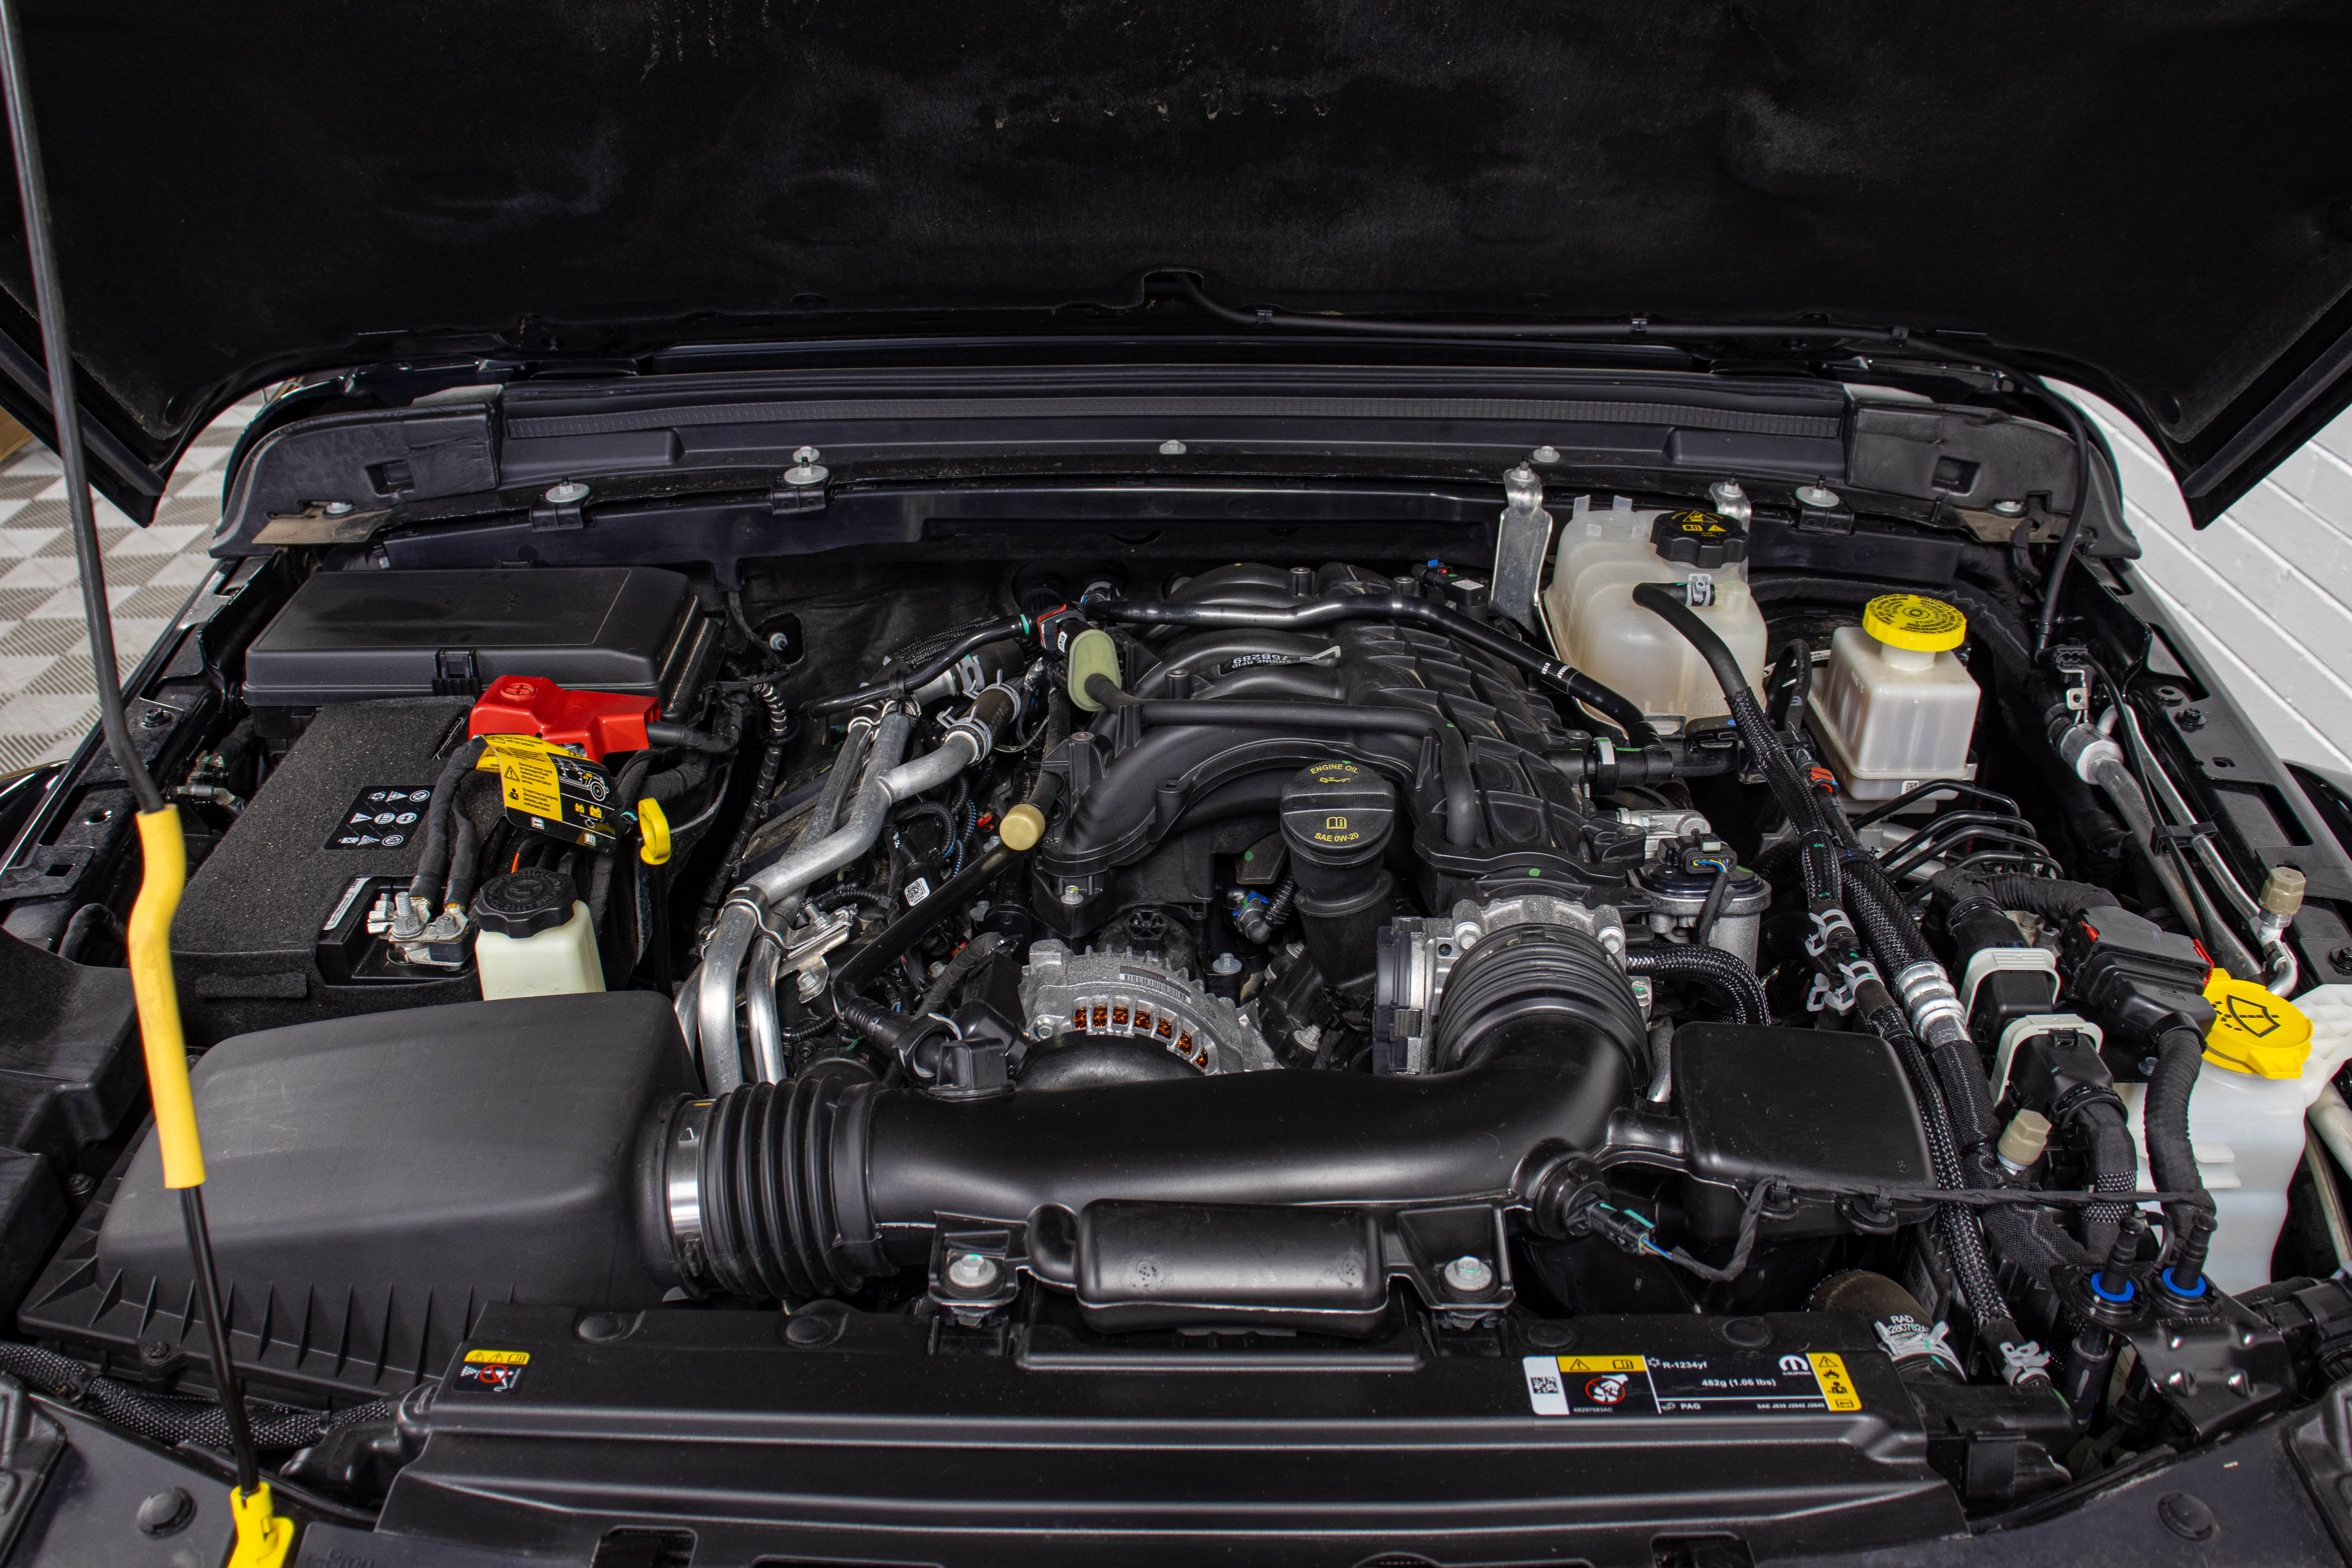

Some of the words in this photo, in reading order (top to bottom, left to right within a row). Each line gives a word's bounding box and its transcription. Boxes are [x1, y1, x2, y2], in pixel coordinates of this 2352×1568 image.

[1233, 654, 1288, 664] 75B289
[1310, 764, 1343, 775] ENGINE
[1344, 765, 1359, 774] OIL
[1314, 833, 1332, 842] SAE
[1334, 832, 1360, 842] 0W-20
[1890, 1315, 1914, 1324] RAD
[1663, 1361, 1708, 1369] R-1234yf
[1701, 1378, 1727, 1387] 482g
[1729, 1378, 1755, 1387] (1.06
[1756, 1378, 1776, 1387] lbs)
[1680, 1402, 1701, 1410] PAG
